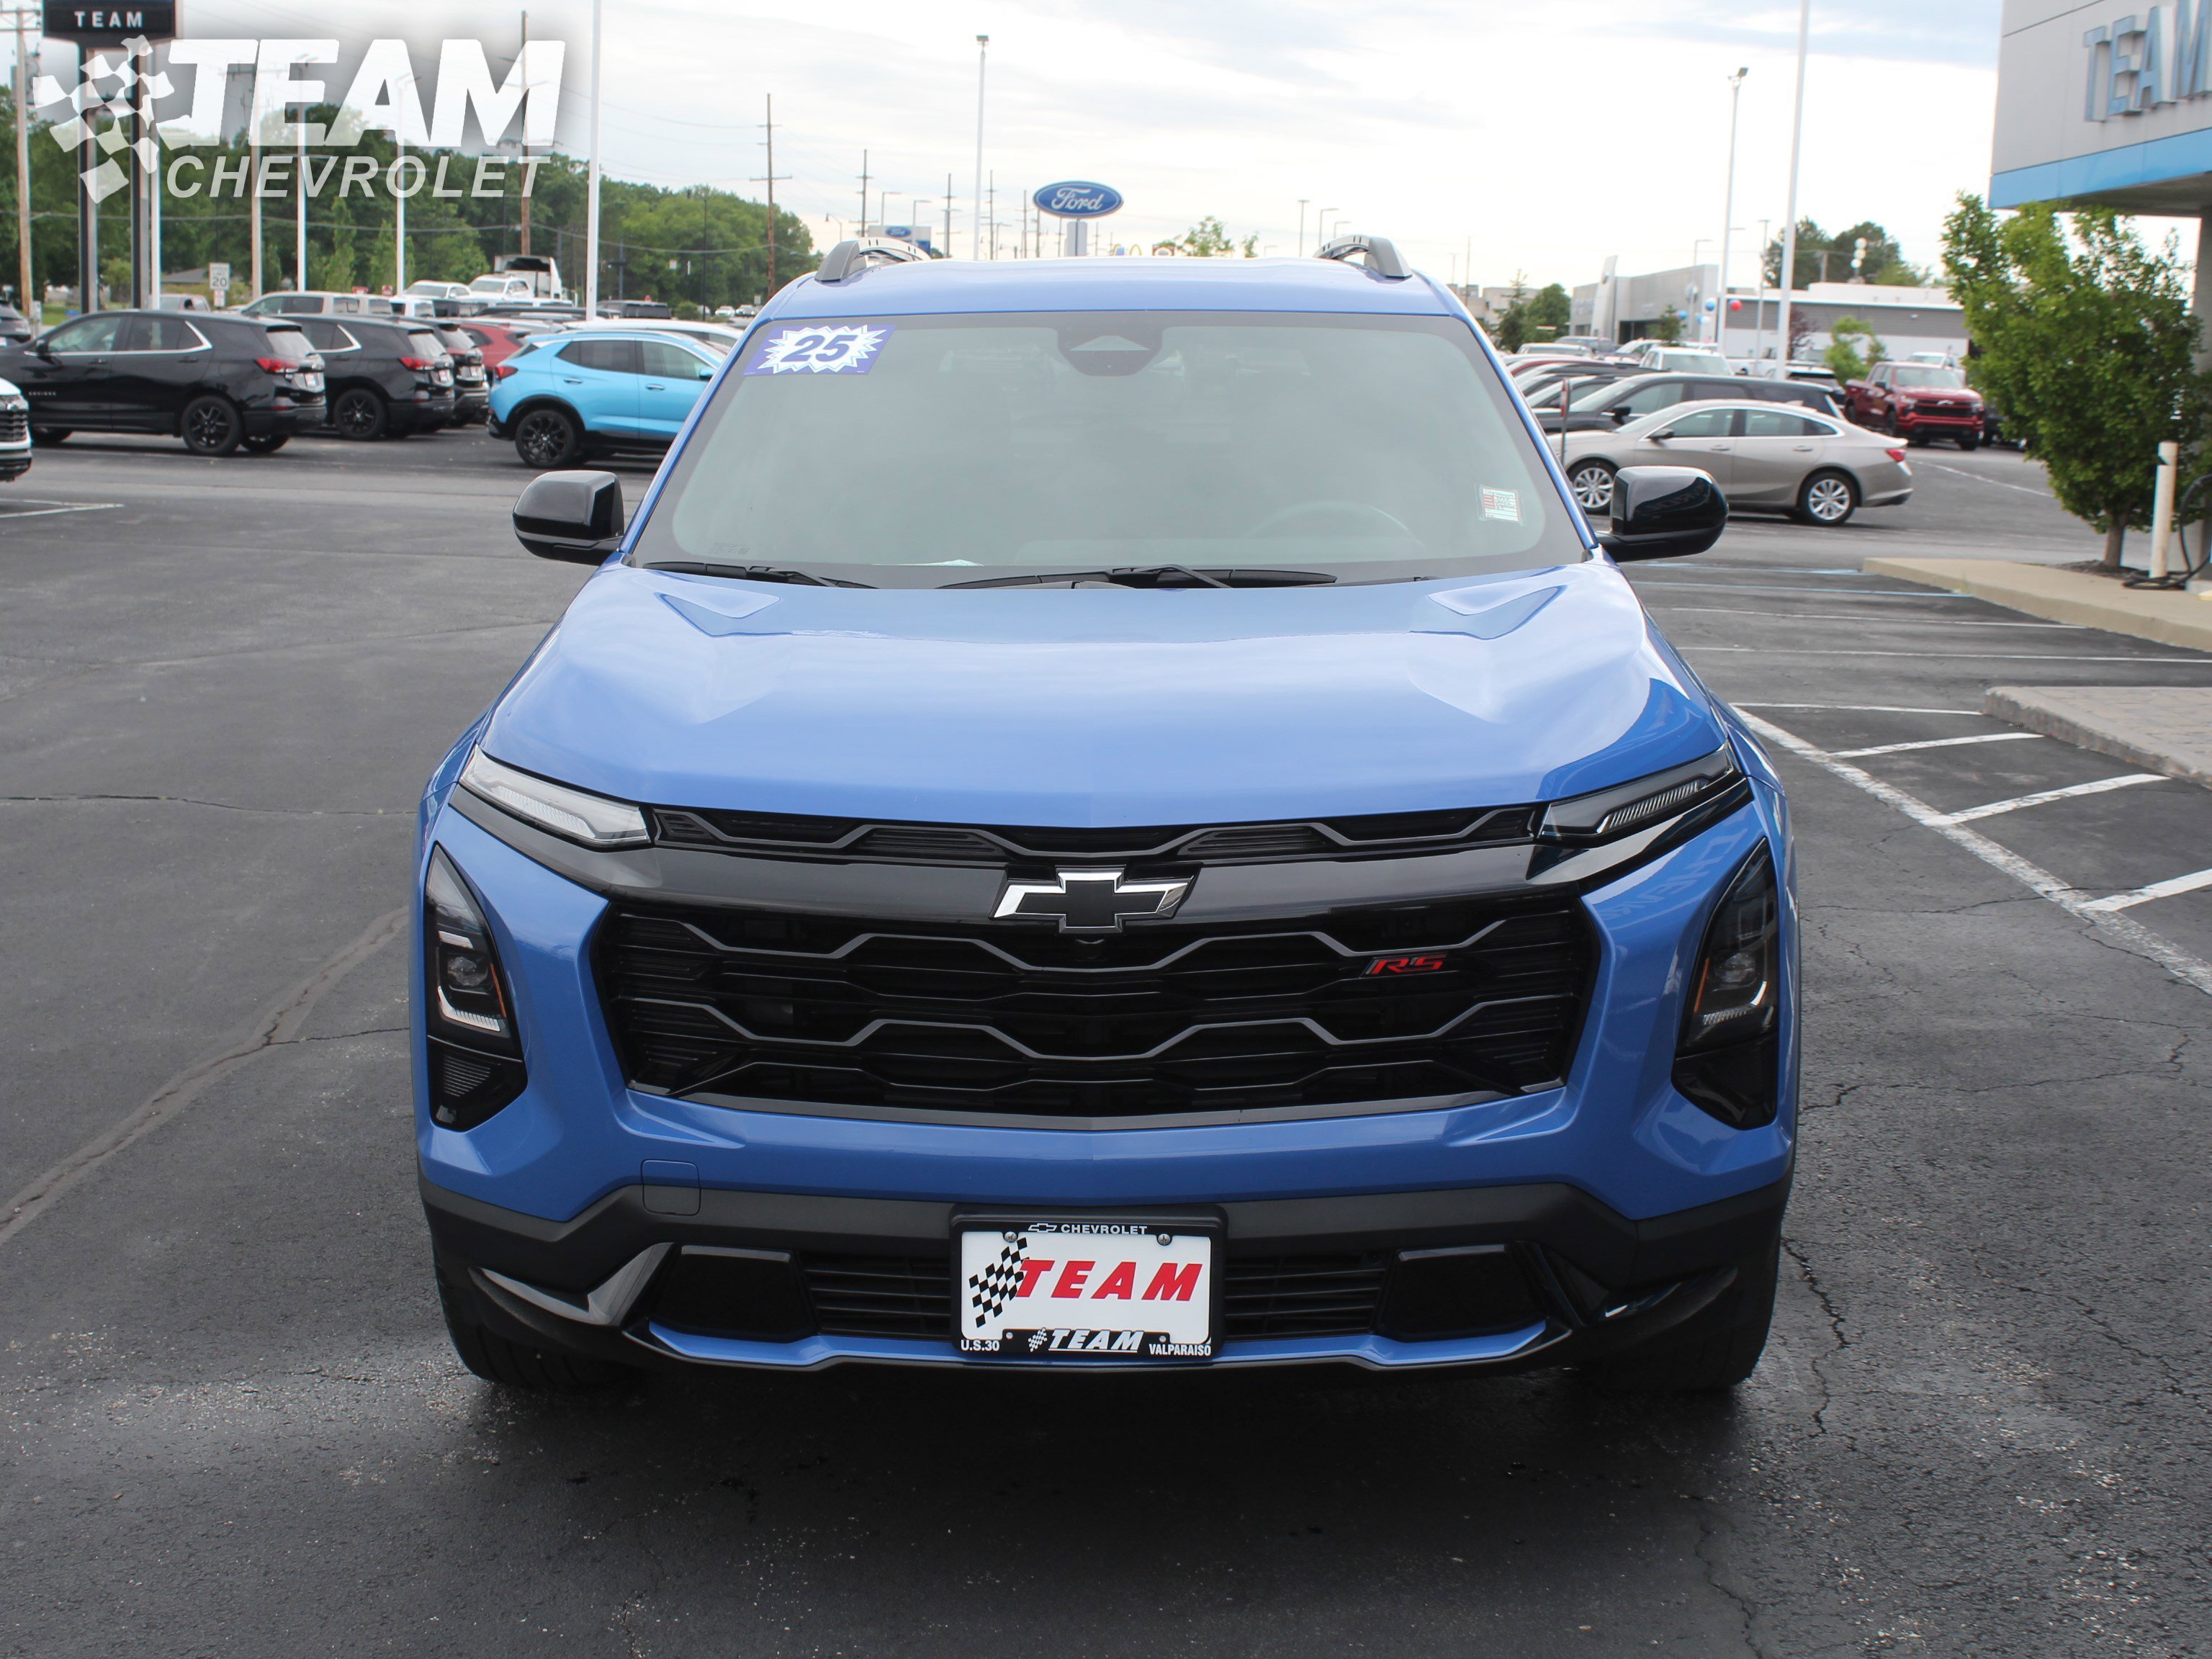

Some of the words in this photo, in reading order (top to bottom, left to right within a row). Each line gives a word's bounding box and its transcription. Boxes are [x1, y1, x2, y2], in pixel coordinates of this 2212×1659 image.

[73, 11, 143, 28] TEAM
[2083, 0, 2212, 122] TEAM
[1051, 187, 1104, 211] Ford
[780, 334, 858, 362] 25
[1365, 955, 1447, 975] RS
[1061, 1224, 1148, 1236] CHEVROLET
[1015, 1259, 1202, 1302] TEAM
[961, 1339, 1000, 1352] U.S.30
[1049, 1329, 1143, 1351] TEAM
[1149, 1344, 1211, 1357] VALPARAISO
